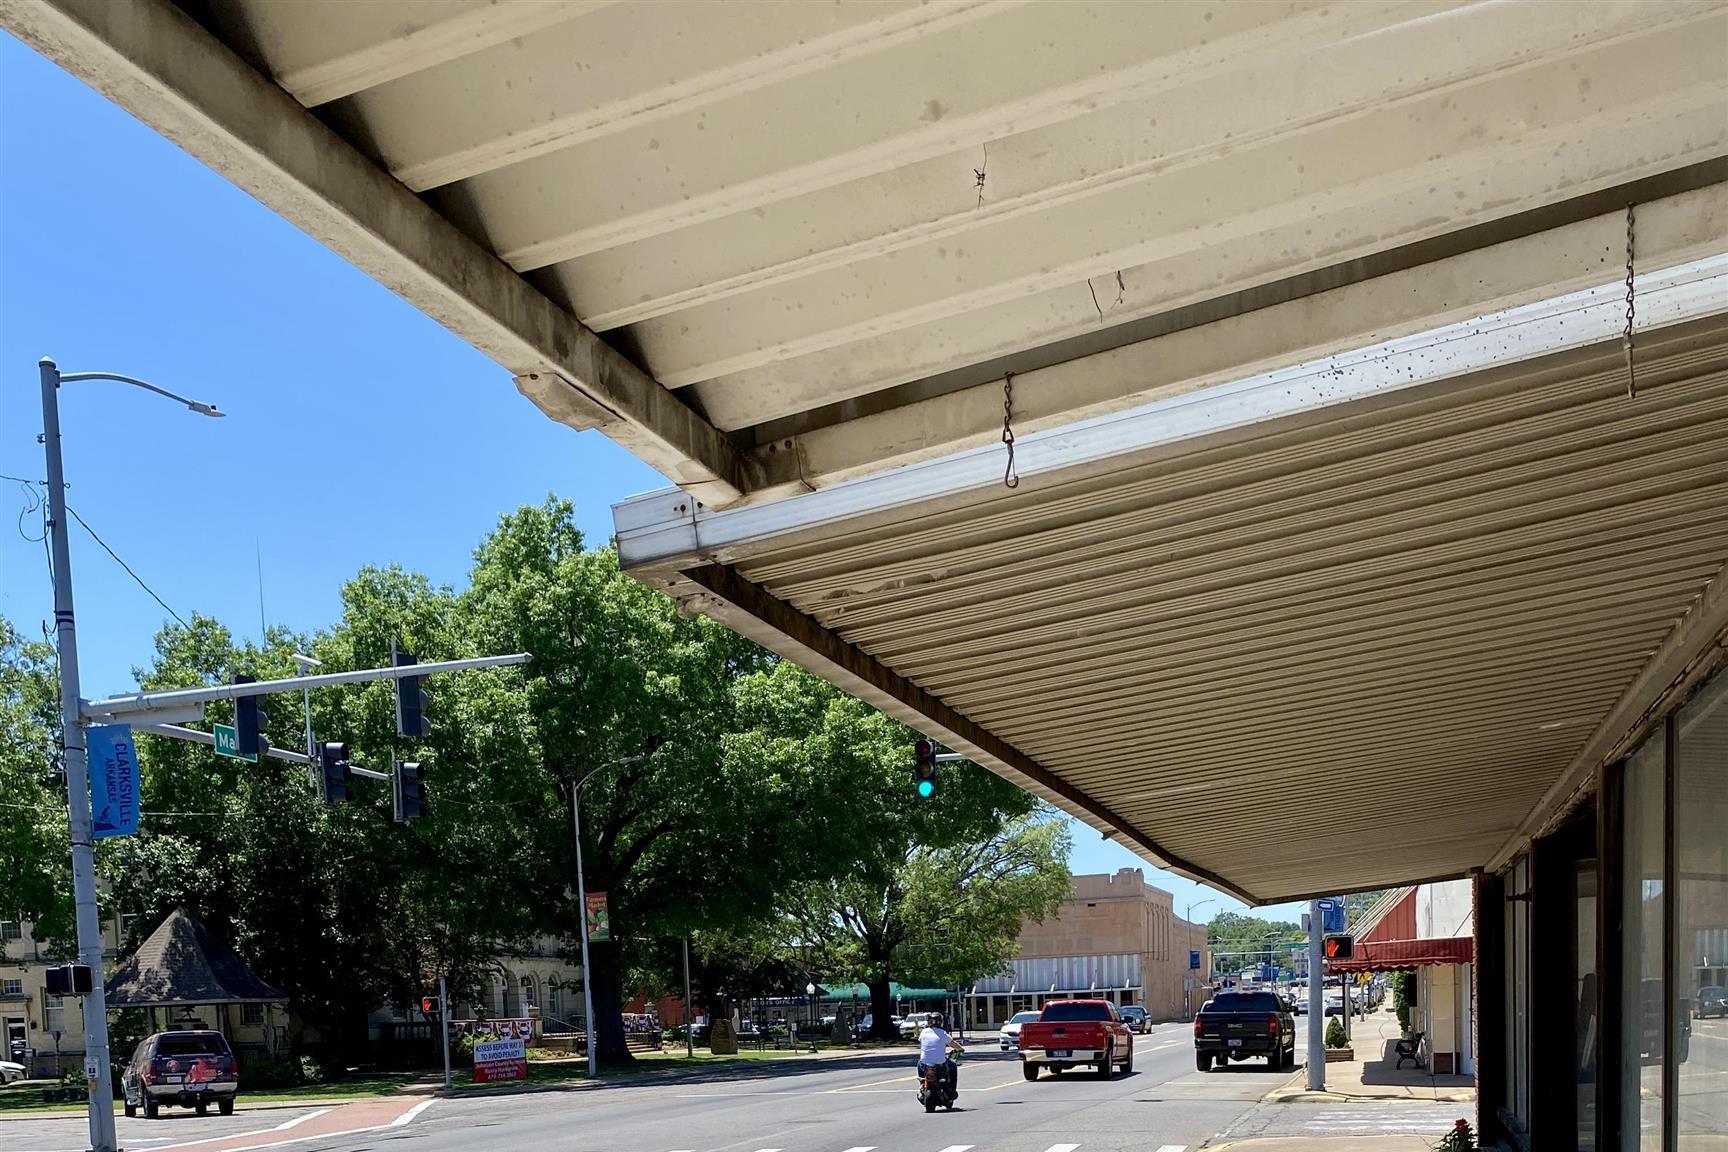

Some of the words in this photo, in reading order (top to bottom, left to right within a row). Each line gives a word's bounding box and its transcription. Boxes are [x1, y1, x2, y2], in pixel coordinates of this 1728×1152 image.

[105, 757, 117, 804] ARKANSAS
[114, 743, 133, 826] CLARKSVILLE
[493, 1043, 509, 1051] BEFORE
[502, 1050, 520, 1058] PENALTY
